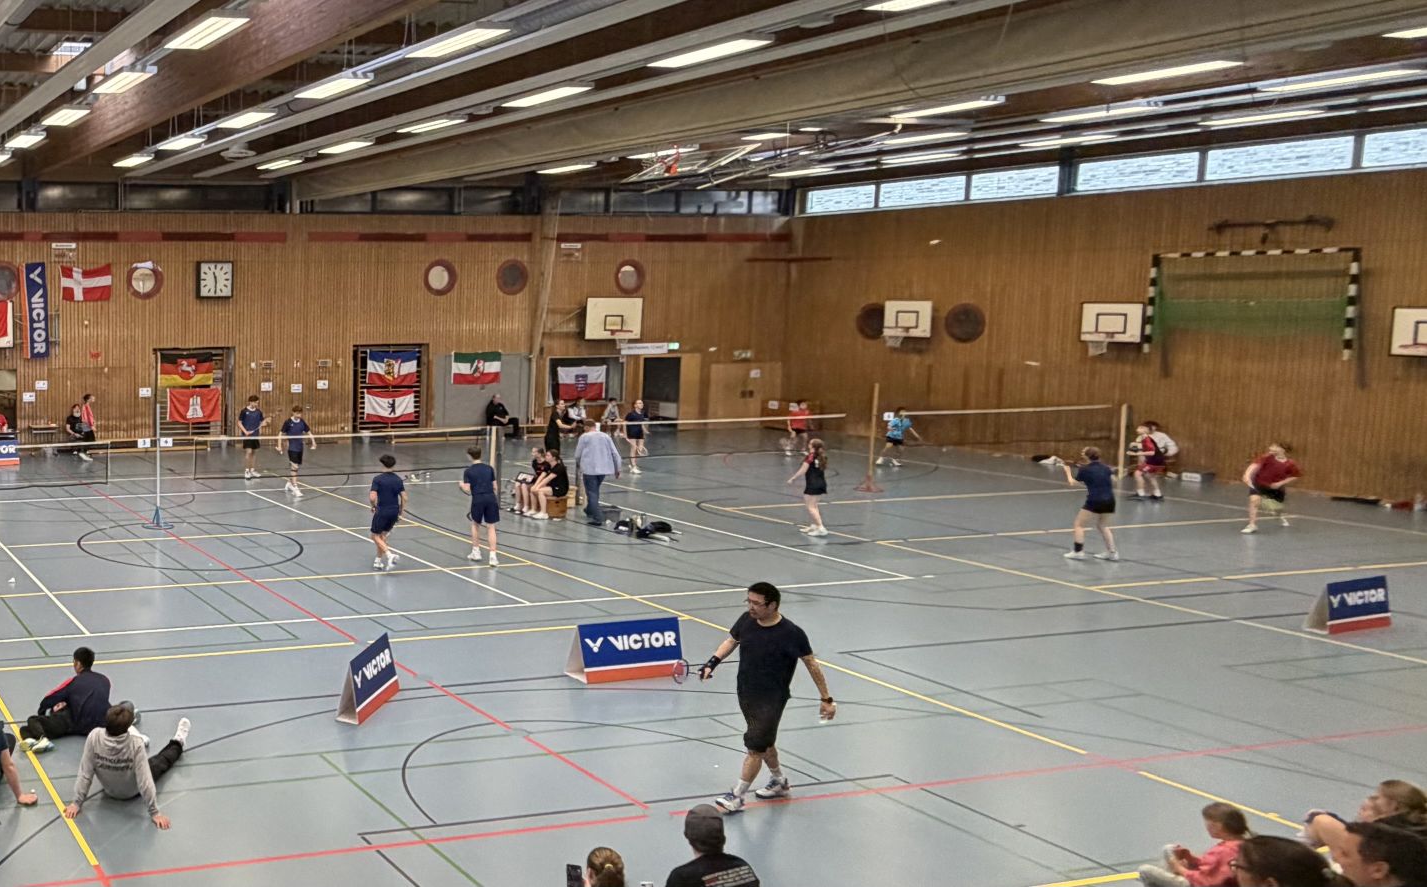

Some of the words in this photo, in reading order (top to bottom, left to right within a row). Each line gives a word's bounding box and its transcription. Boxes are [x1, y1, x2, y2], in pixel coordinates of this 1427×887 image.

[31, 287, 47, 354] VICTOR
[1342, 587, 1386, 606] VICTOR
[607, 631, 677, 651] VICTOR
[362, 647, 392, 681] VICTOR
